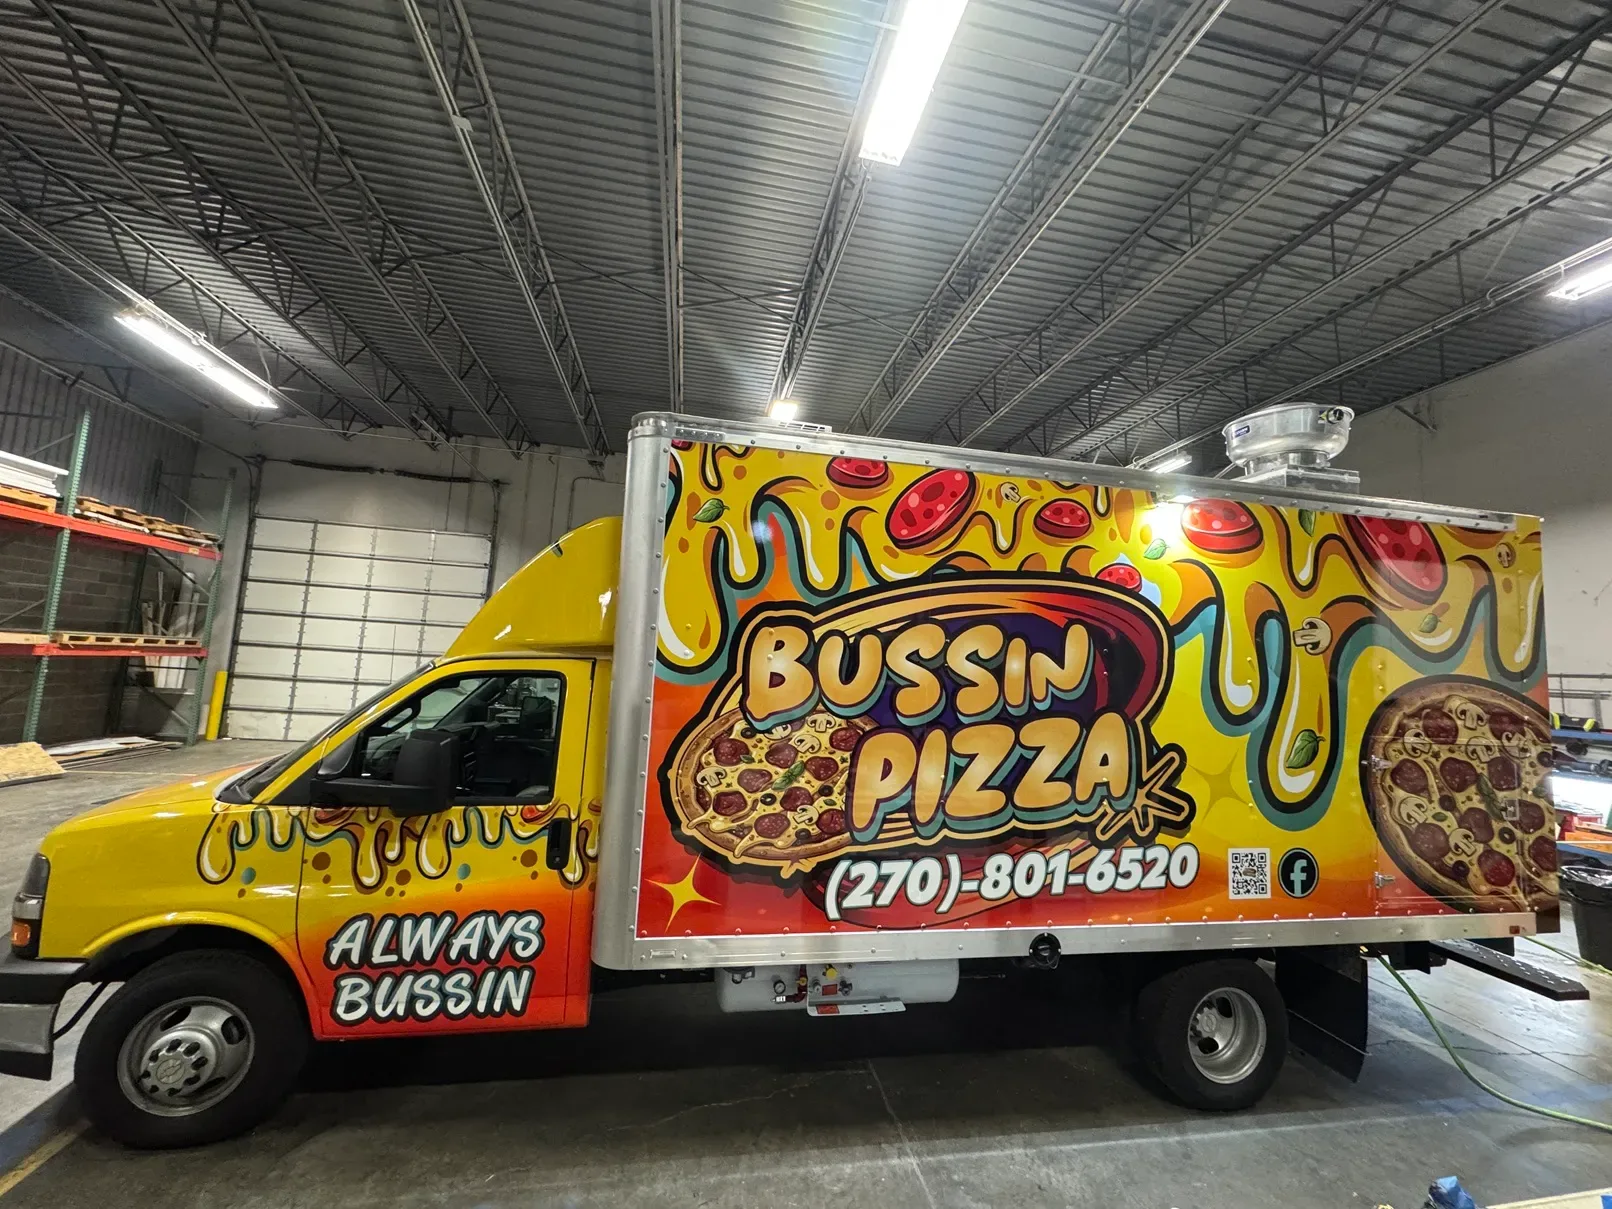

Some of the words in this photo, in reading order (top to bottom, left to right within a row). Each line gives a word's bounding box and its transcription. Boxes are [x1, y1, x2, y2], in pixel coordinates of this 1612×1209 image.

[742, 622, 1093, 727] BUSSIN
[849, 711, 1134, 837] PIZZA
[825, 843, 1200, 921] (270)-801-6520
[326, 911, 543, 967] ALWAYS
[333, 967, 533, 1023] BUSSIN
